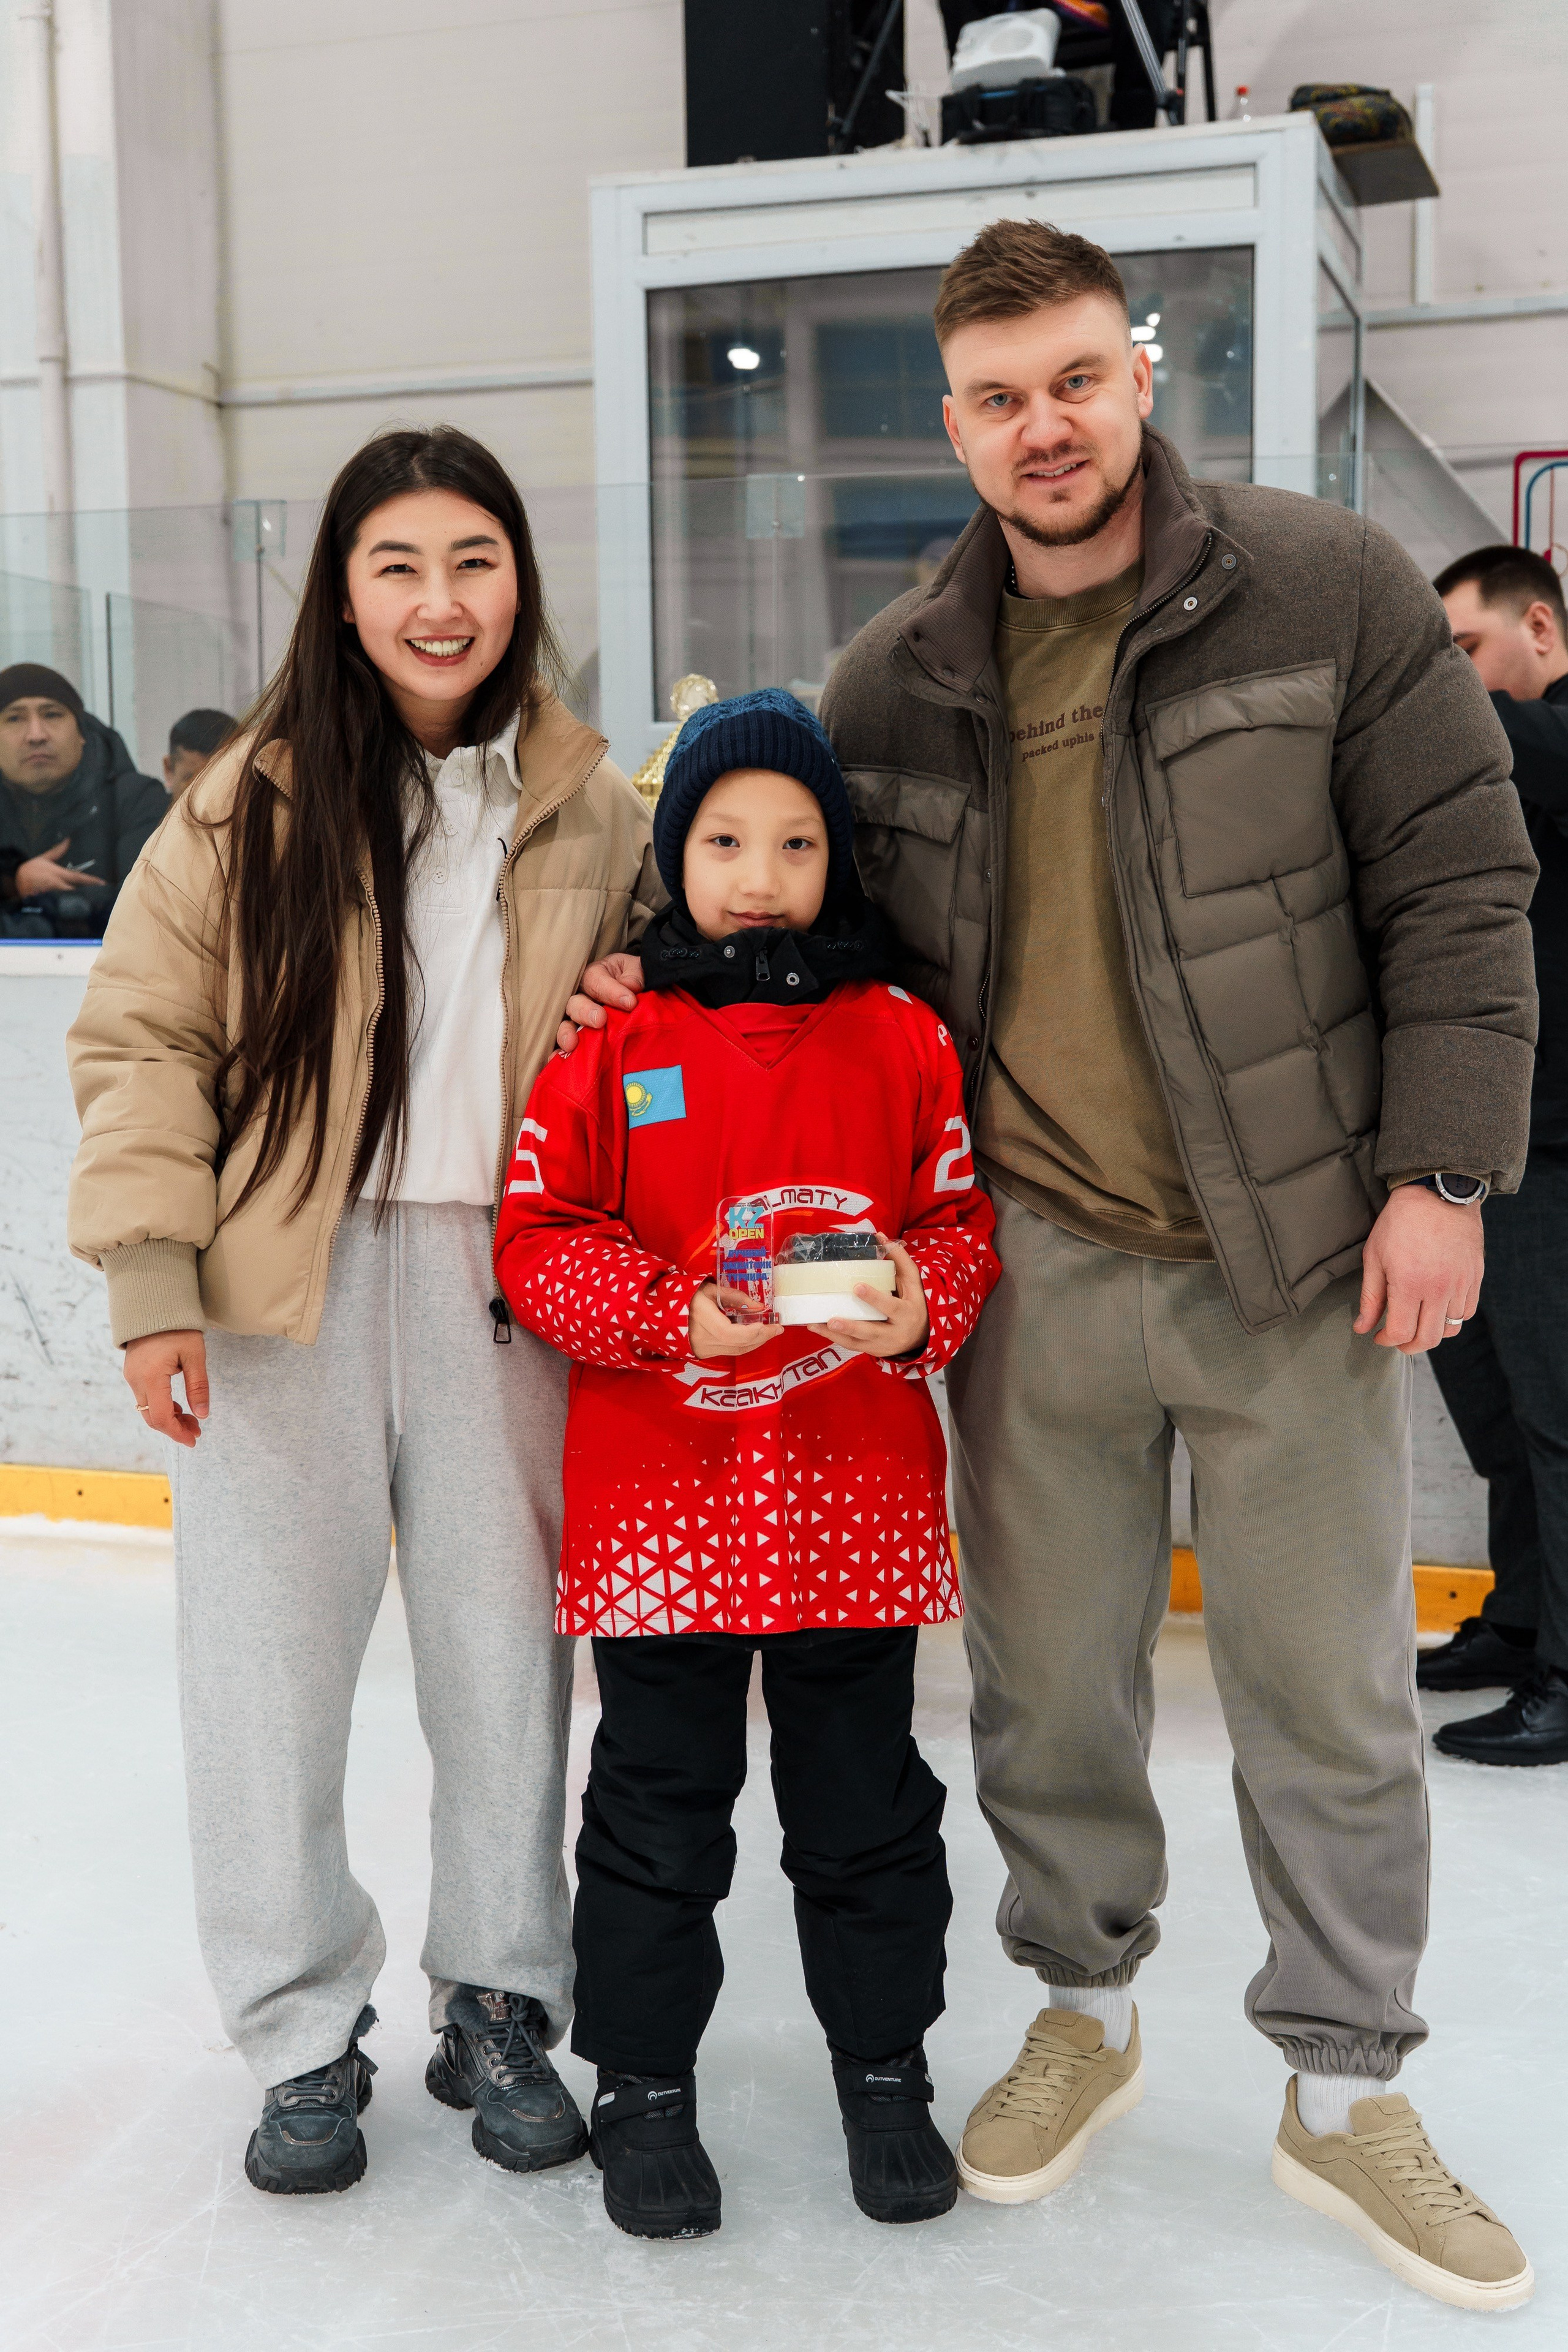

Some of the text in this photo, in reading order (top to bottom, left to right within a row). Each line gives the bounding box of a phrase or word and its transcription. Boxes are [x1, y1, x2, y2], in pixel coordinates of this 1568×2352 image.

[1072, 705, 1103, 723] the
[1022, 740, 1059, 762] packed
[1062, 732, 1095, 748] uphis
[933, 1115, 975, 1193] 2
[729, 1207, 764, 1229] KZ
[729, 1228, 764, 1240] OPEN
[657, 2088, 682, 2097] OUTVENTURE
